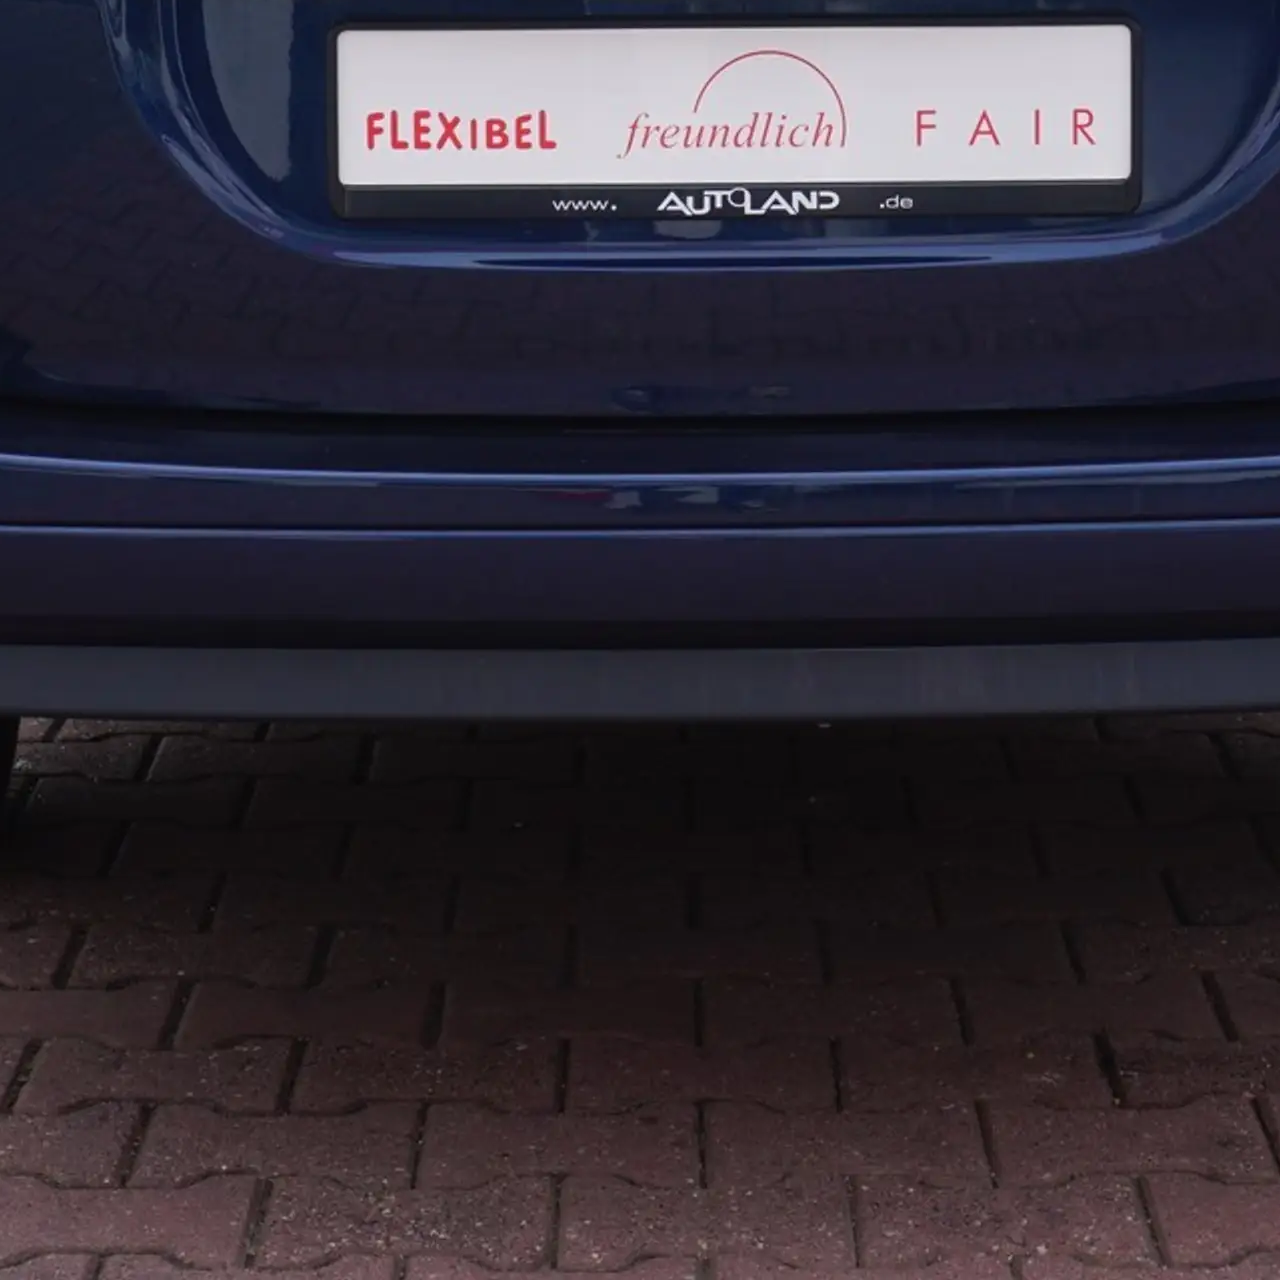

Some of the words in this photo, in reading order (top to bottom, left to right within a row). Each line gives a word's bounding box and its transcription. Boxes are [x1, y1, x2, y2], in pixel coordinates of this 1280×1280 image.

[365, 108, 558, 151] FLEXIBEL
[615, 110, 836, 159] freundlich
[915, 107, 1097, 147] FAIR
[551, 198, 618, 211] www.
[656, 186, 841, 216] AUTOLAND
[879, 194, 914, 210] .de
